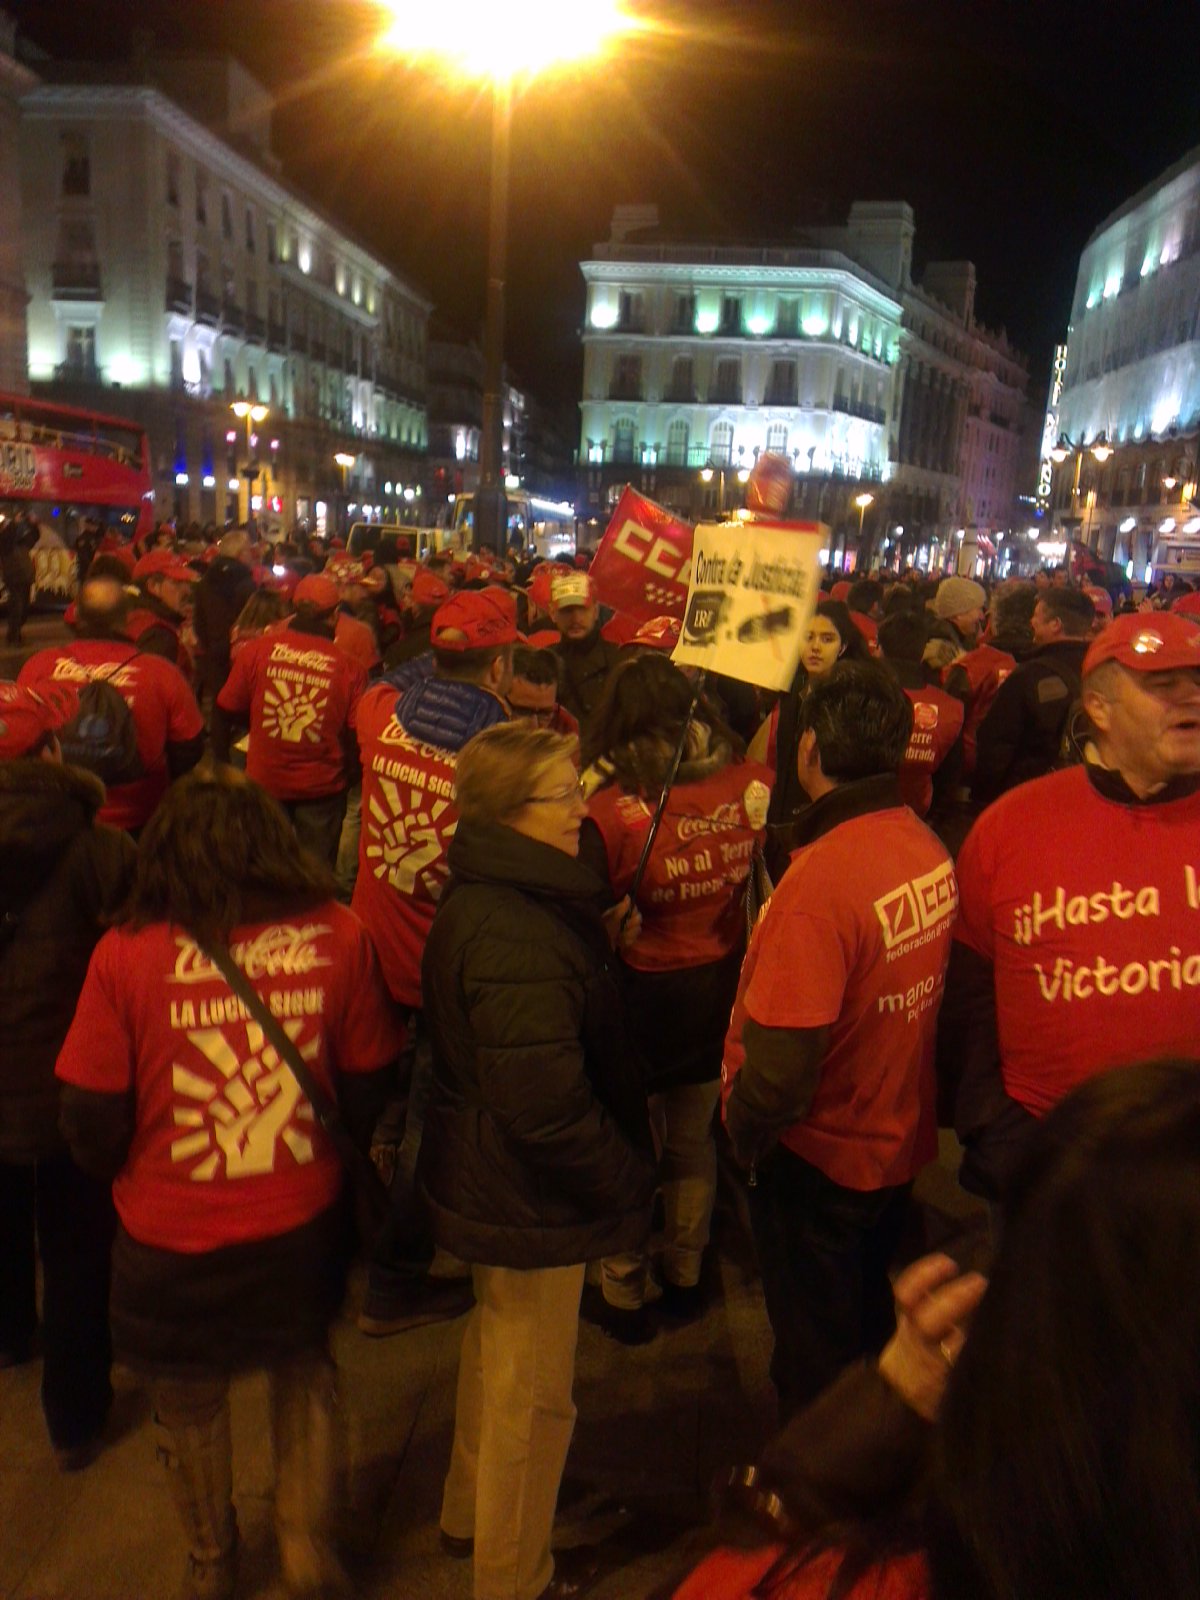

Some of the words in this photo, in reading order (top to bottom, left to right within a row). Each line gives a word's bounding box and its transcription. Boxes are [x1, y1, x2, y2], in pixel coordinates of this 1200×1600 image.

[696, 550, 725, 586] Contra
[372, 755, 386, 774] LA
[385, 760, 427, 789] LUCHA
[665, 855, 689, 880] No
[694, 849, 713, 873] al
[1184, 864, 1200, 910] l
[886, 926, 936, 964] federación
[1033, 945, 1200, 1002] Victoria
[878, 975, 935, 1014] mano
[170, 1000, 196, 1030] LA
